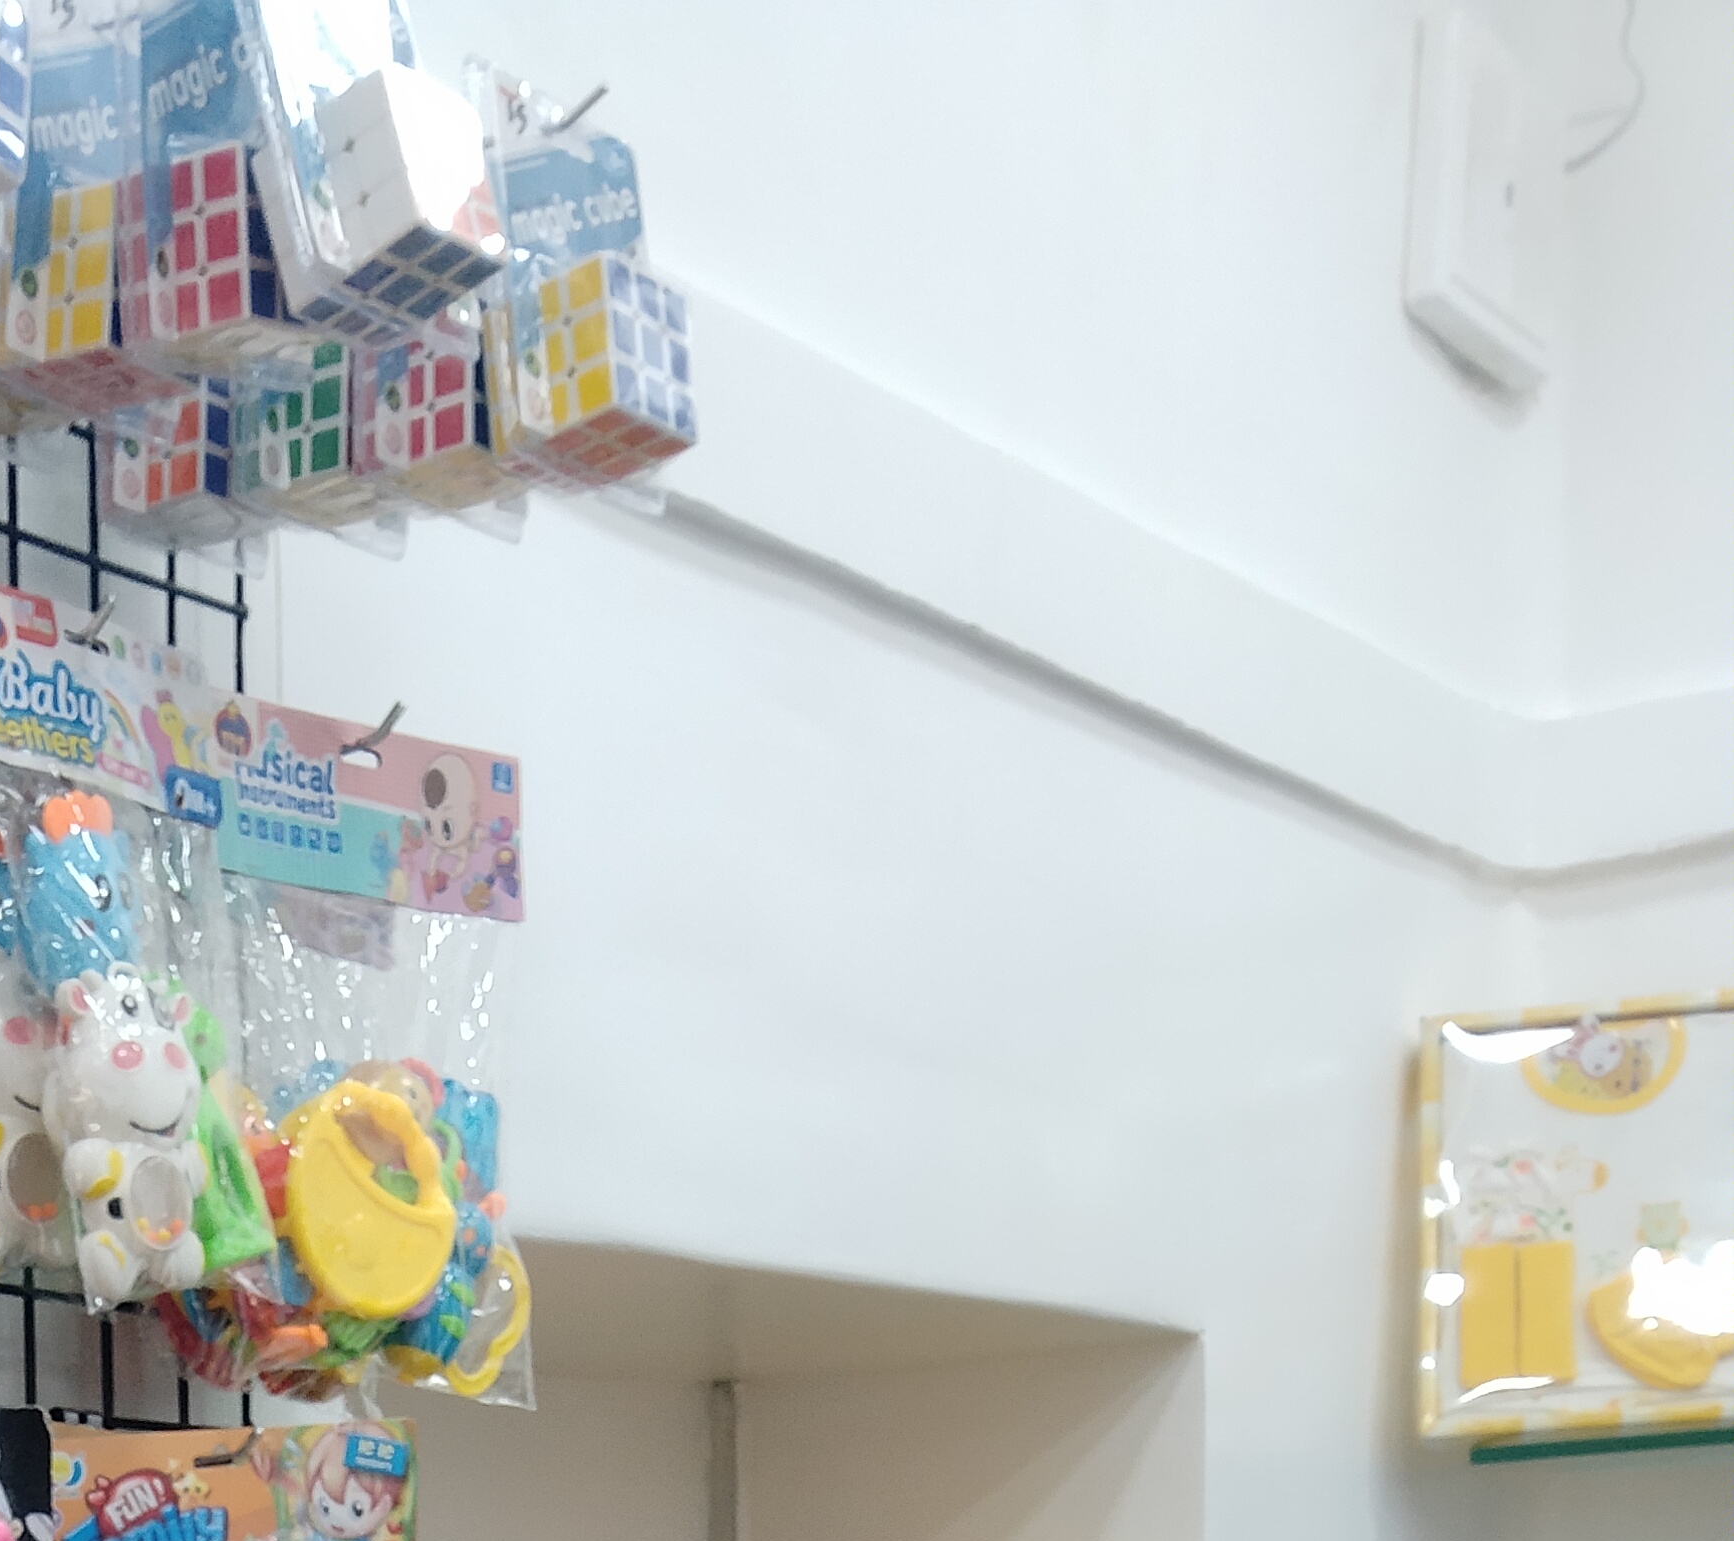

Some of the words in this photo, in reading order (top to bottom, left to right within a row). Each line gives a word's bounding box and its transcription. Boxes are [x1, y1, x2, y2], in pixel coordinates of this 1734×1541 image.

[147, 44, 228, 122] magic
[32, 97, 117, 156] magic
[104, 1476, 166, 1531] FUN!
